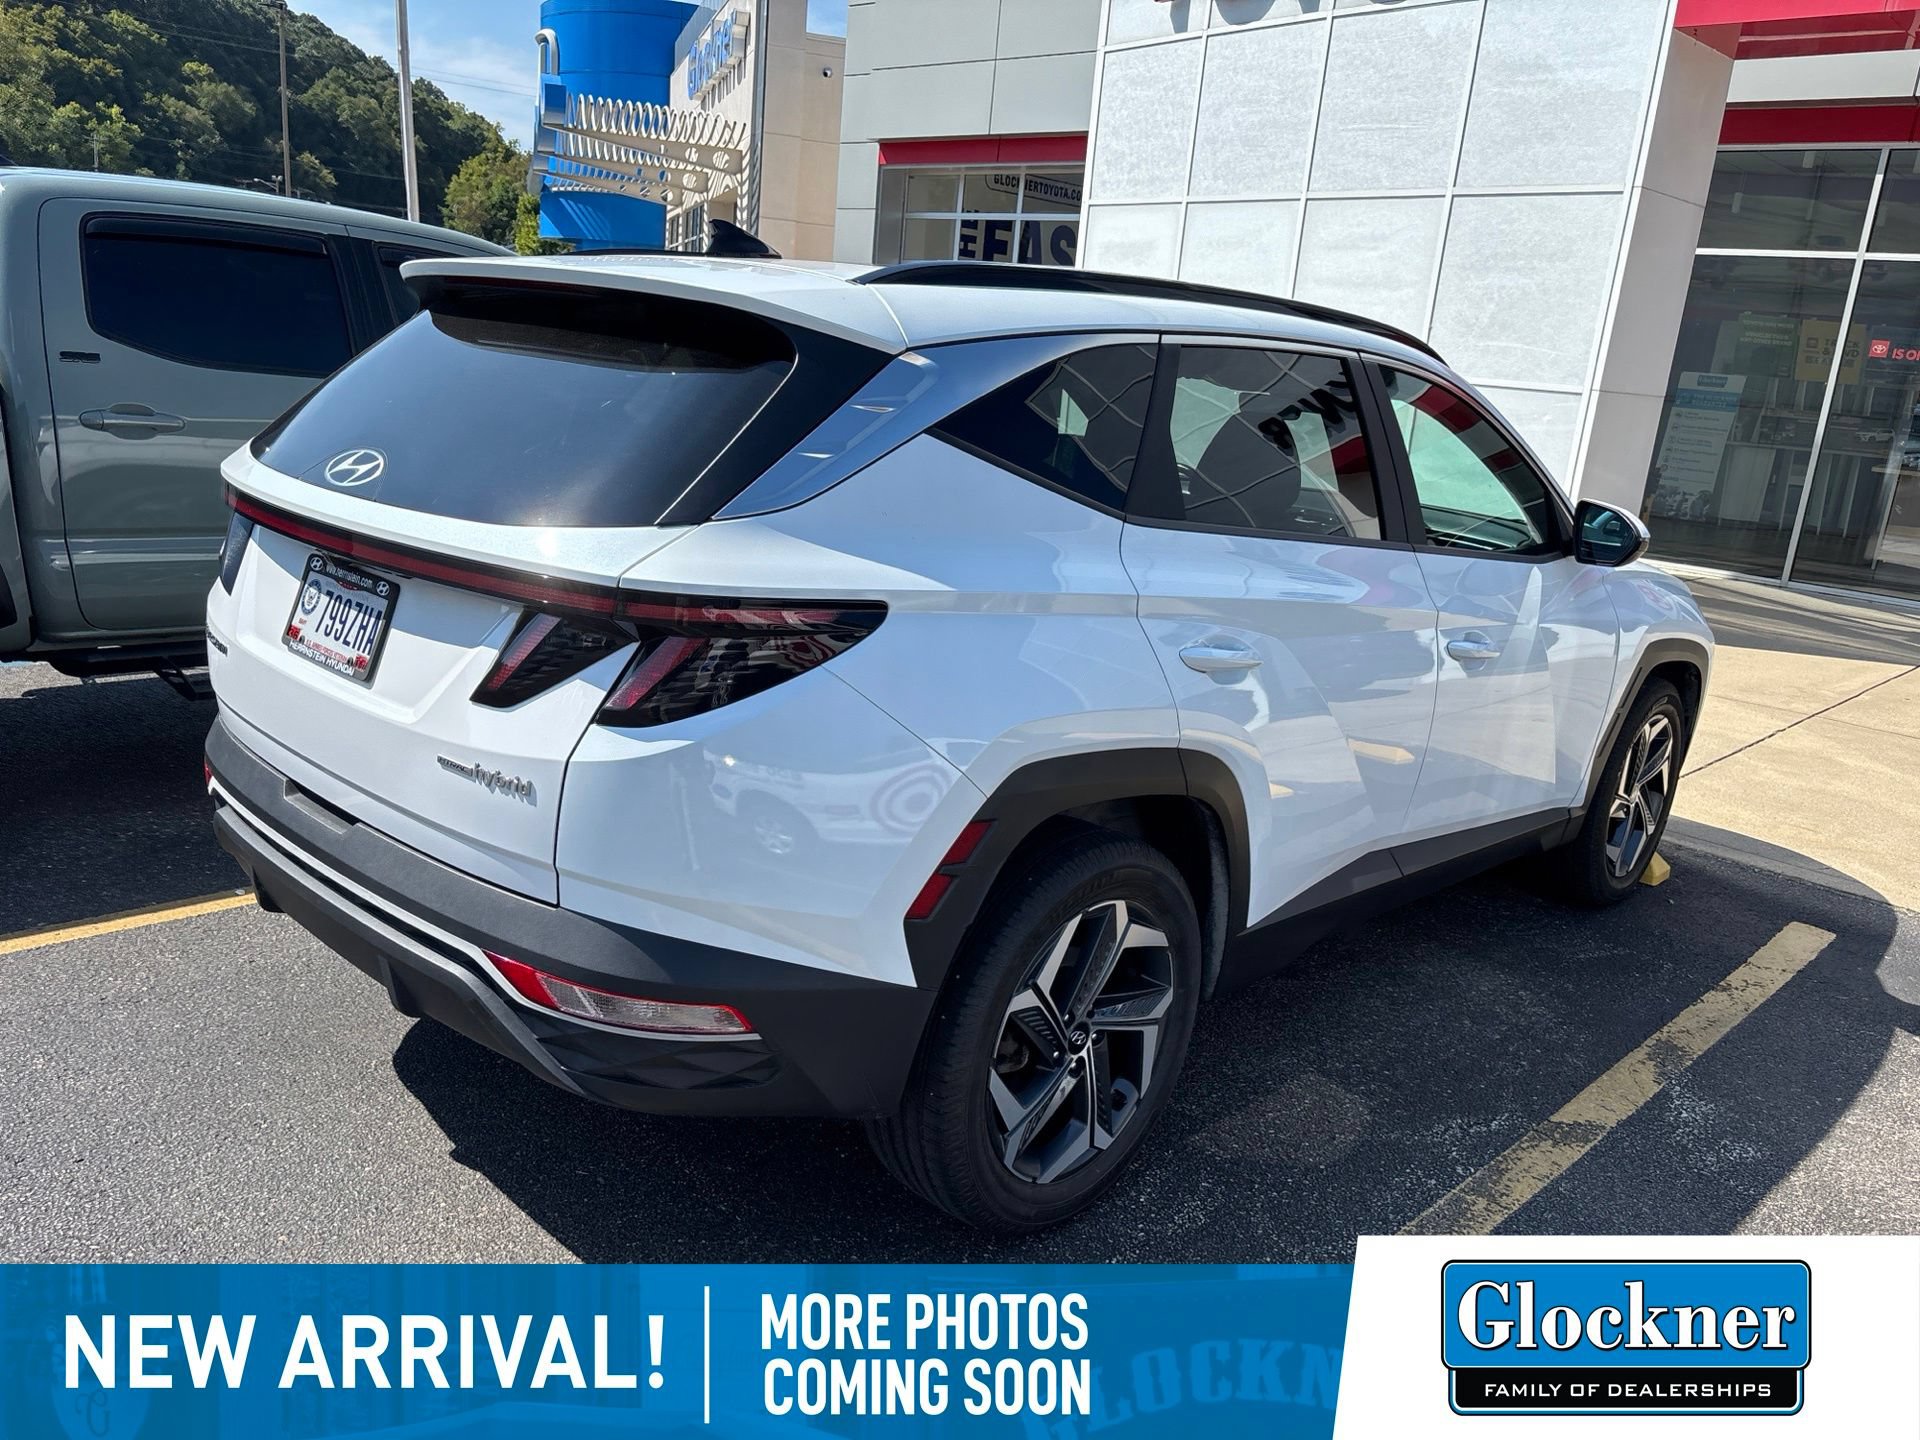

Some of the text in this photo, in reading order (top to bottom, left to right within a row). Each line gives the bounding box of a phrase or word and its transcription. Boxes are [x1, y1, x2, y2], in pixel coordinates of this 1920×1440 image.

[1891, 348, 1905, 360] IS
[315, 590, 382, 656] 799ZHA
[326, 658, 354, 677] HYUNDAI
